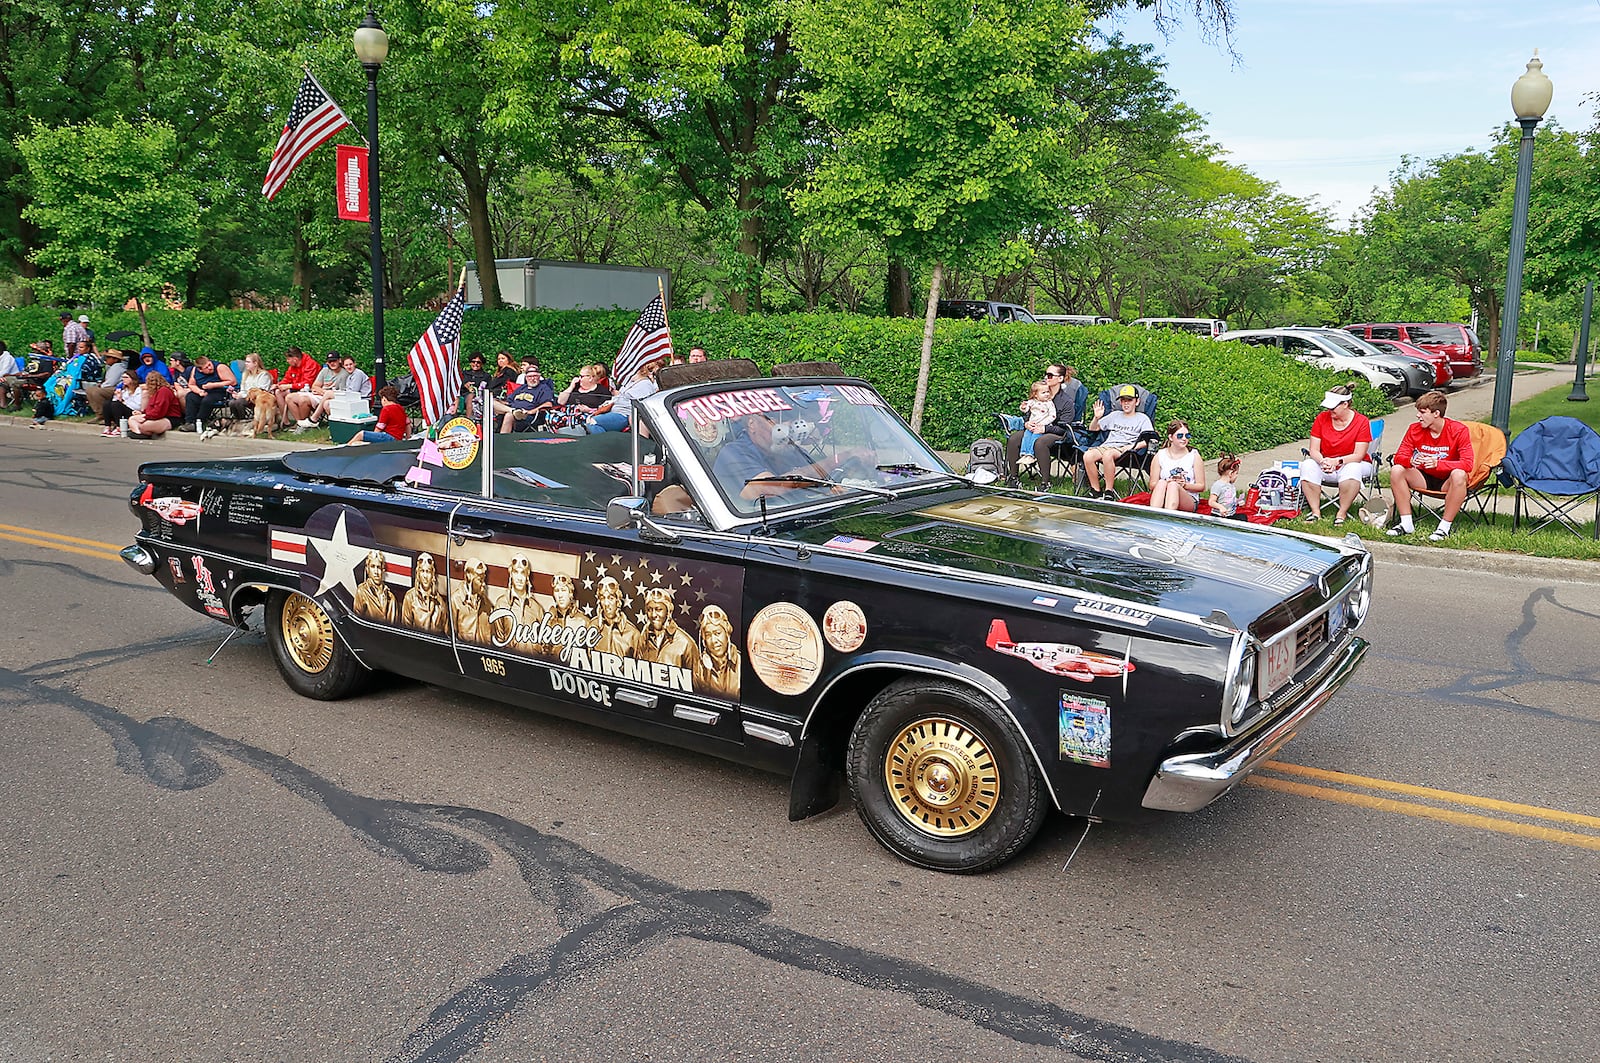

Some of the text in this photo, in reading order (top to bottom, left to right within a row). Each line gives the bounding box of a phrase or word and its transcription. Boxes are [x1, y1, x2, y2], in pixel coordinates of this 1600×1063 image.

[681, 389, 792, 426] TUSKEGEE
[1077, 599, 1112, 611] STAY
[1111, 605, 1156, 622] ALIVE!
[489, 607, 601, 662] Tuskegee
[1013, 646, 1057, 660] E4 2
[480, 655, 506, 677] 1965
[569, 647, 693, 692] AIRMEN
[550, 668, 612, 707] DODGE
[939, 742, 979, 805] TUSKEGEE AIRMEN
